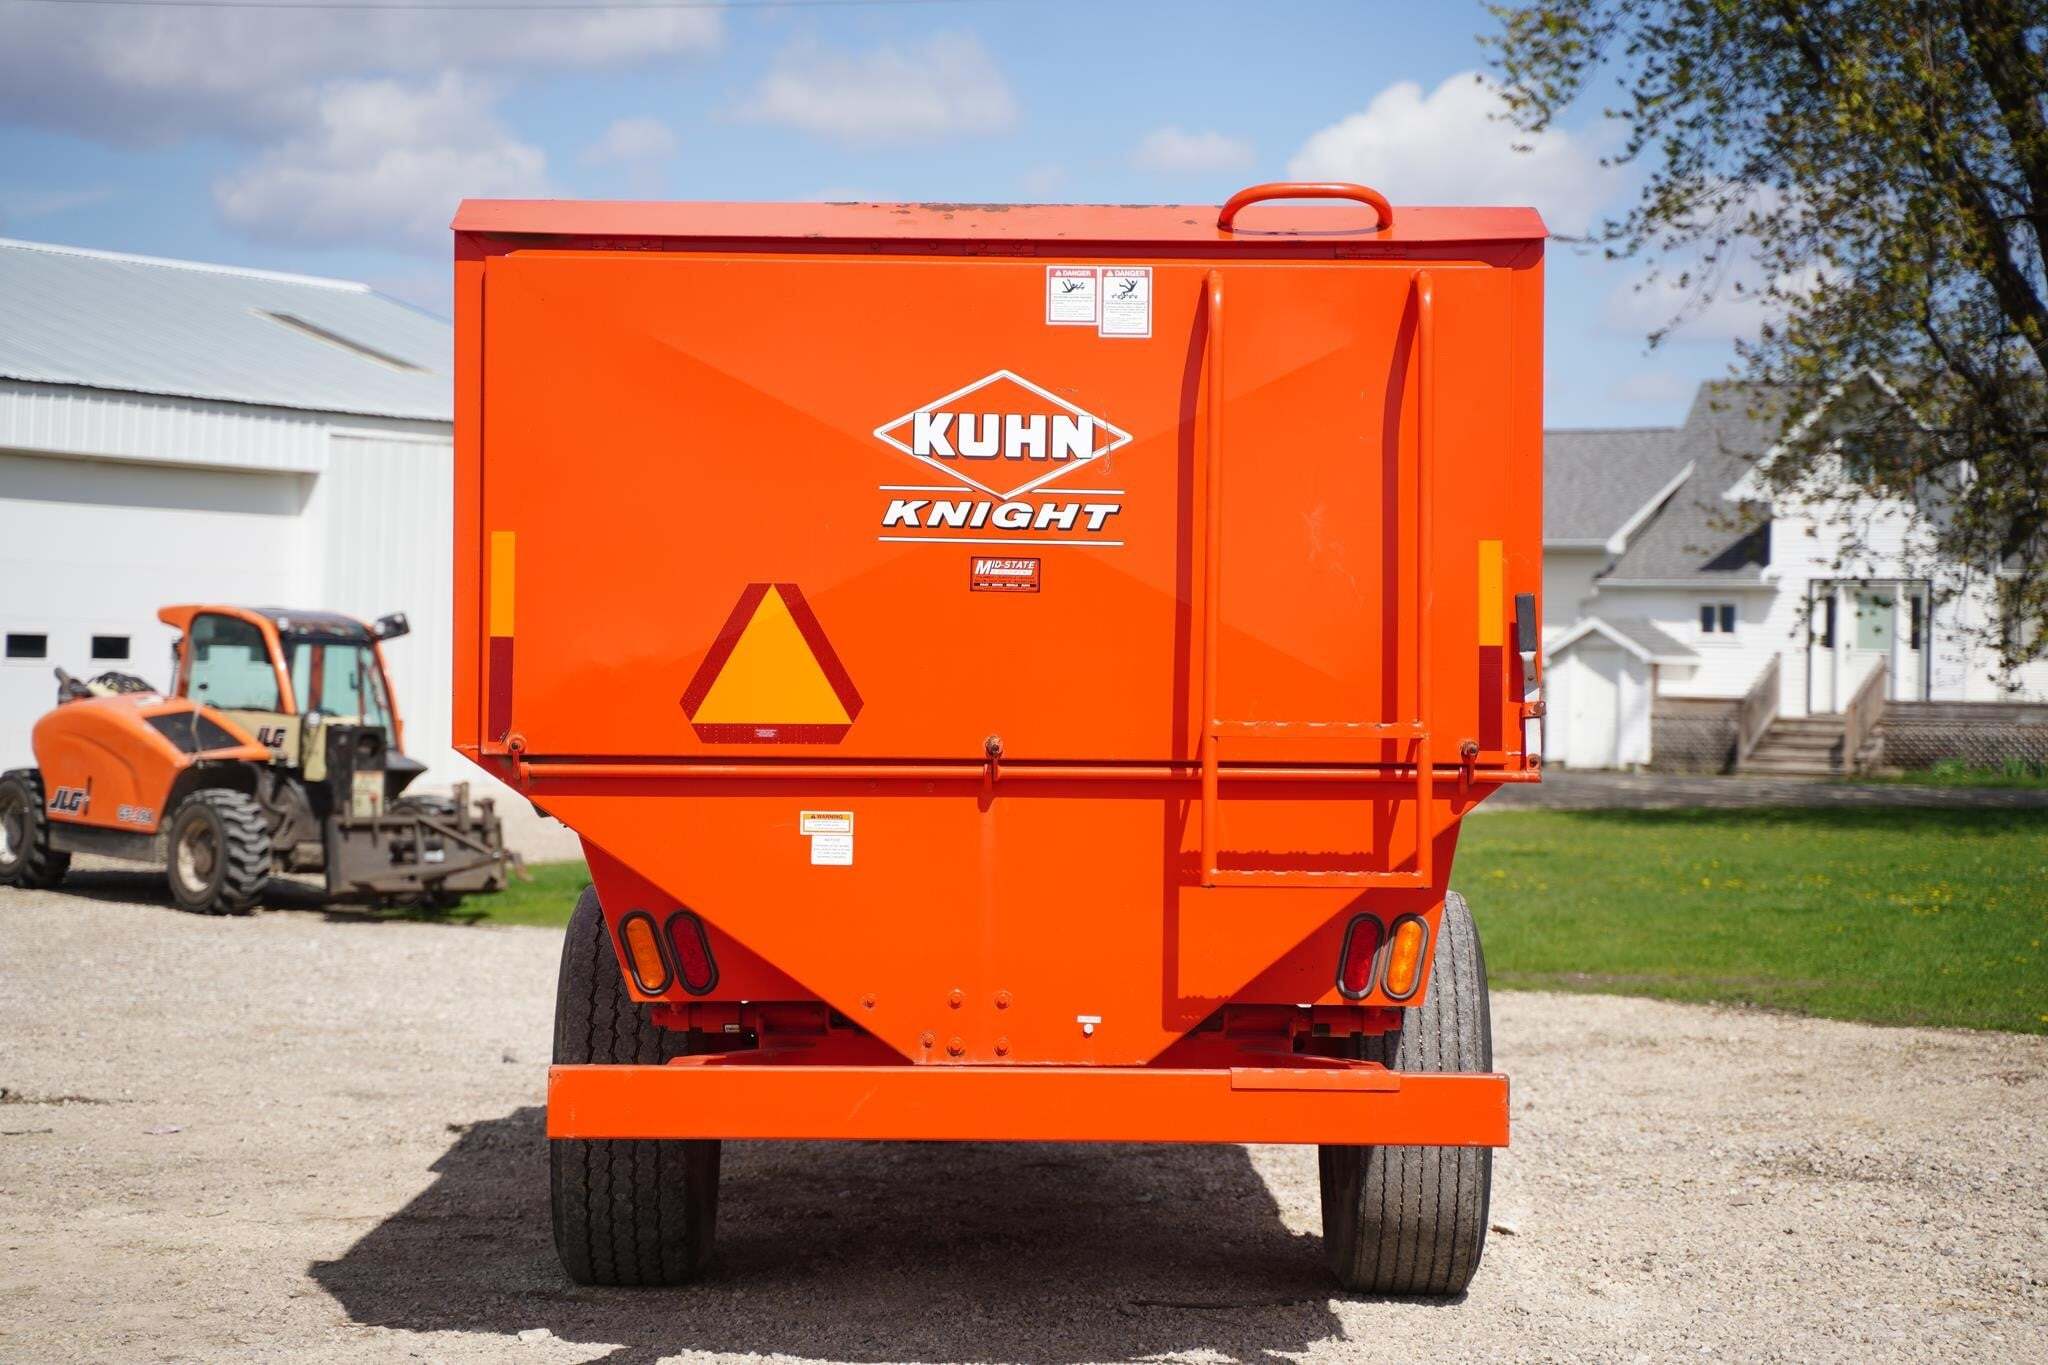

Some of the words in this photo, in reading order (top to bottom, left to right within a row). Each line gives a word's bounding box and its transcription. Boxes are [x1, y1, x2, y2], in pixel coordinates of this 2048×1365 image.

[1062, 269, 1092, 277] DANGER
[913, 412, 1093, 460] KUHN
[881, 499, 1121, 531] KNIGHT
[258, 727, 286, 748] JLG
[49, 788, 84, 812] JLG
